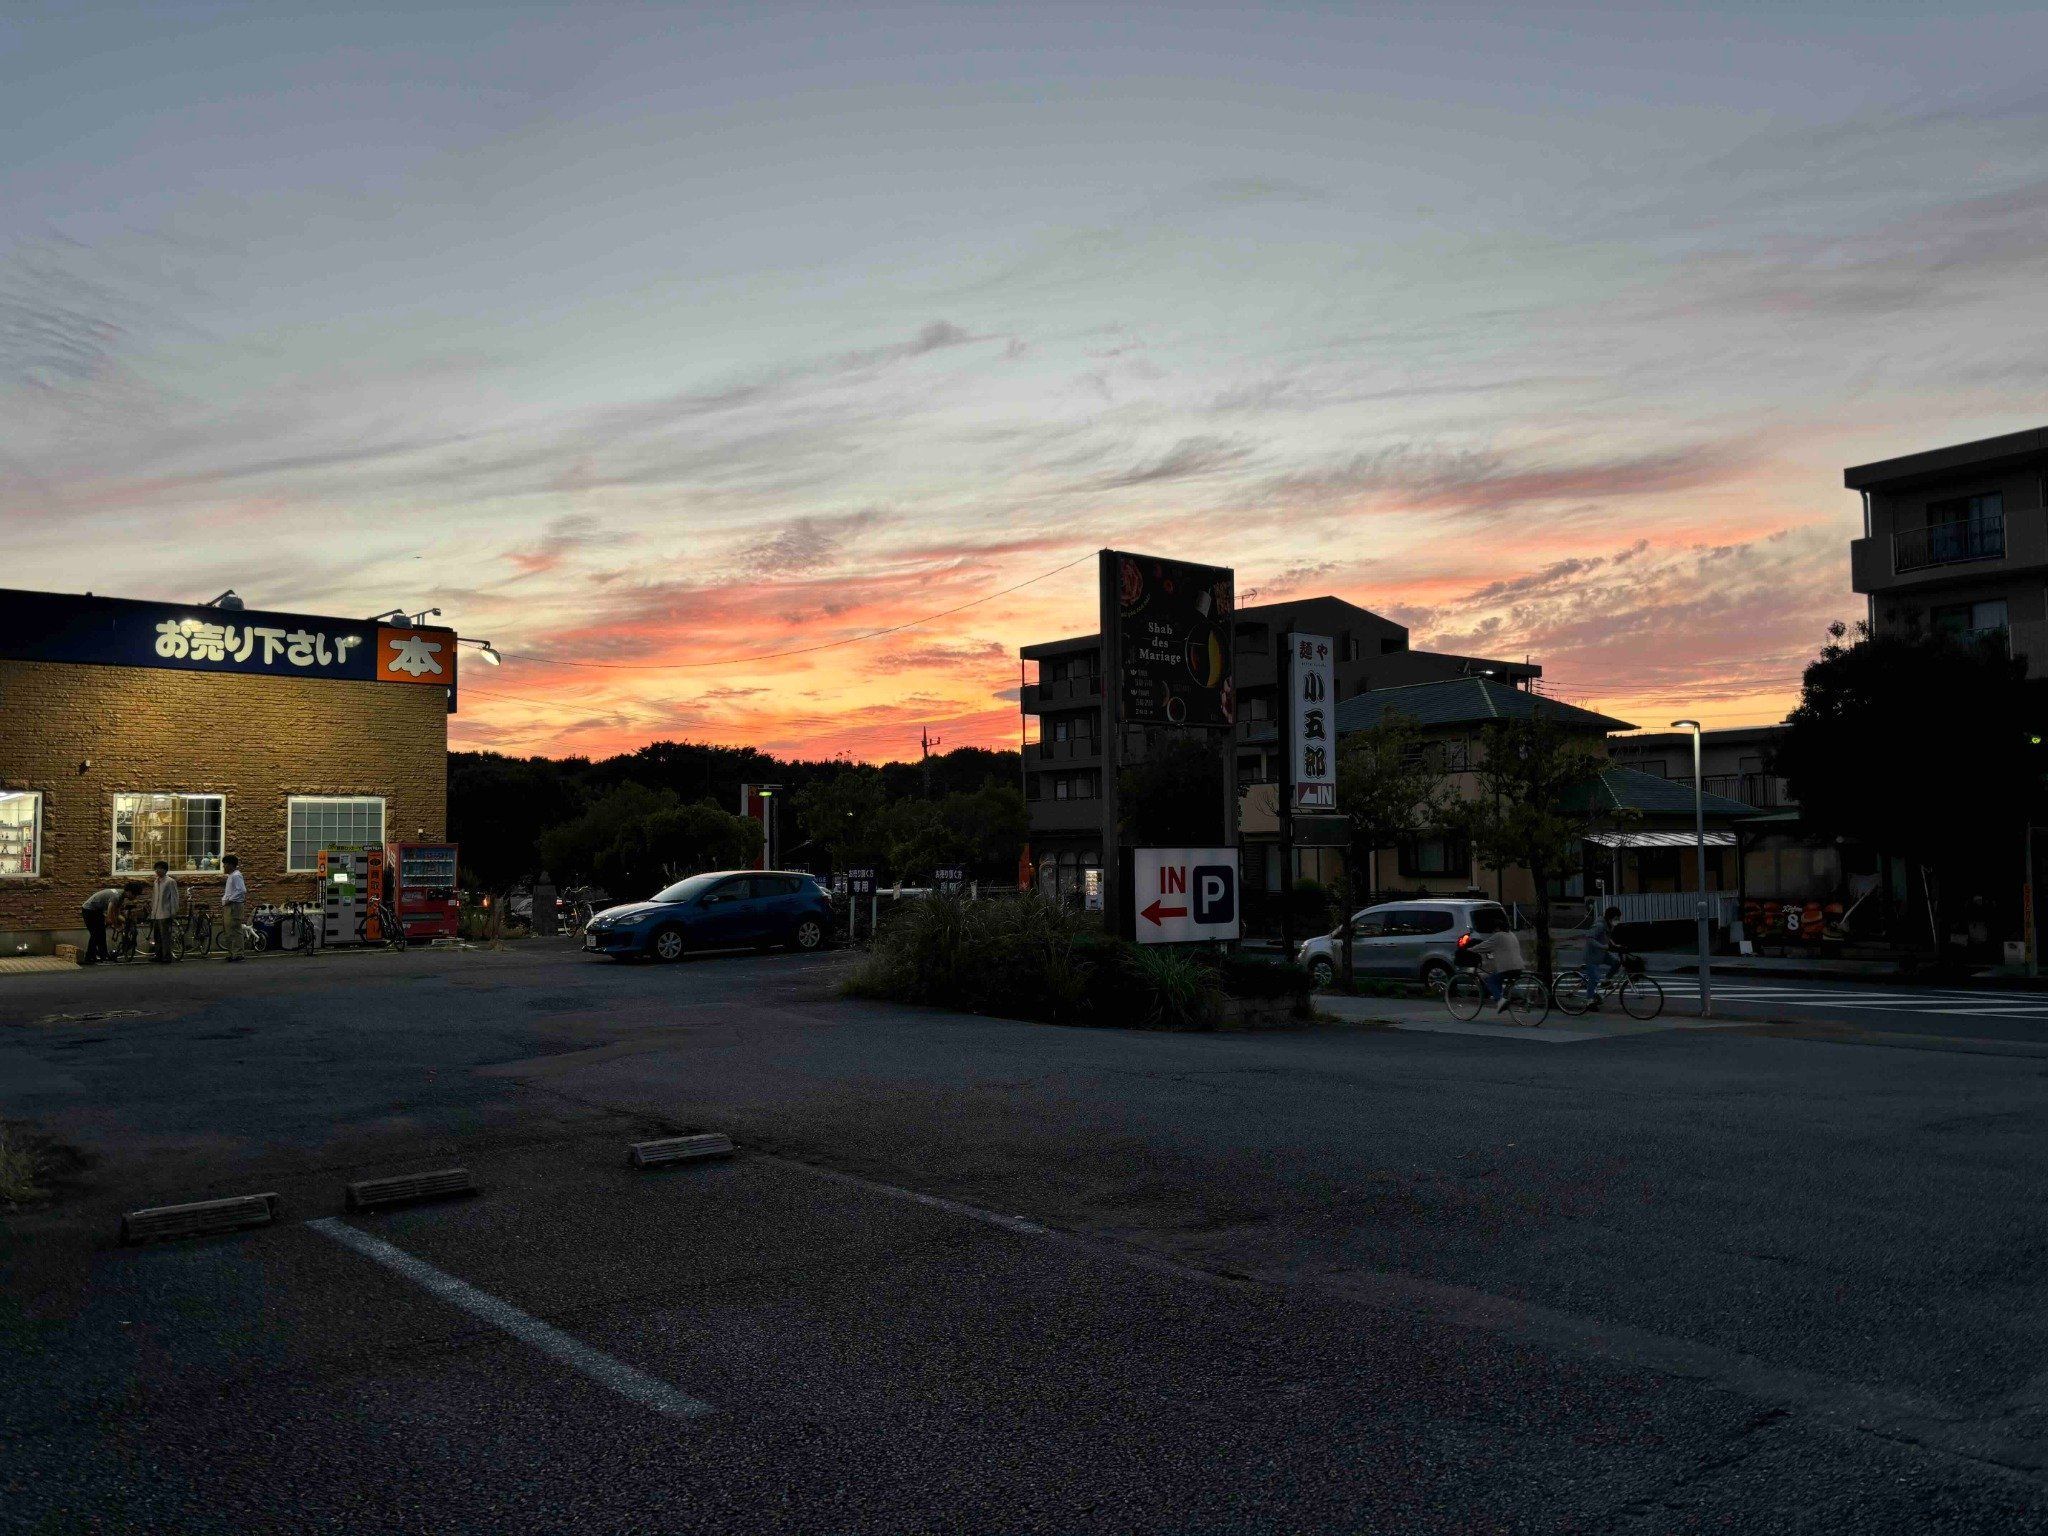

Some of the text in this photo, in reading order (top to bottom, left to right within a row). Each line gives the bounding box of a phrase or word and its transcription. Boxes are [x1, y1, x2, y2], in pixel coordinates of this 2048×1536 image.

[1148, 621, 1173, 635] Shab
[155, 620, 348, 667] お売り下さい
[1151, 636, 1169, 648] des
[388, 635, 443, 677] 本
[1139, 648, 1182, 666] Mariage
[1317, 785, 1333, 805] IN
[1160, 866, 1187, 894] IN
[1201, 875, 1226, 915] P
[1787, 913, 1799, 931] 8
